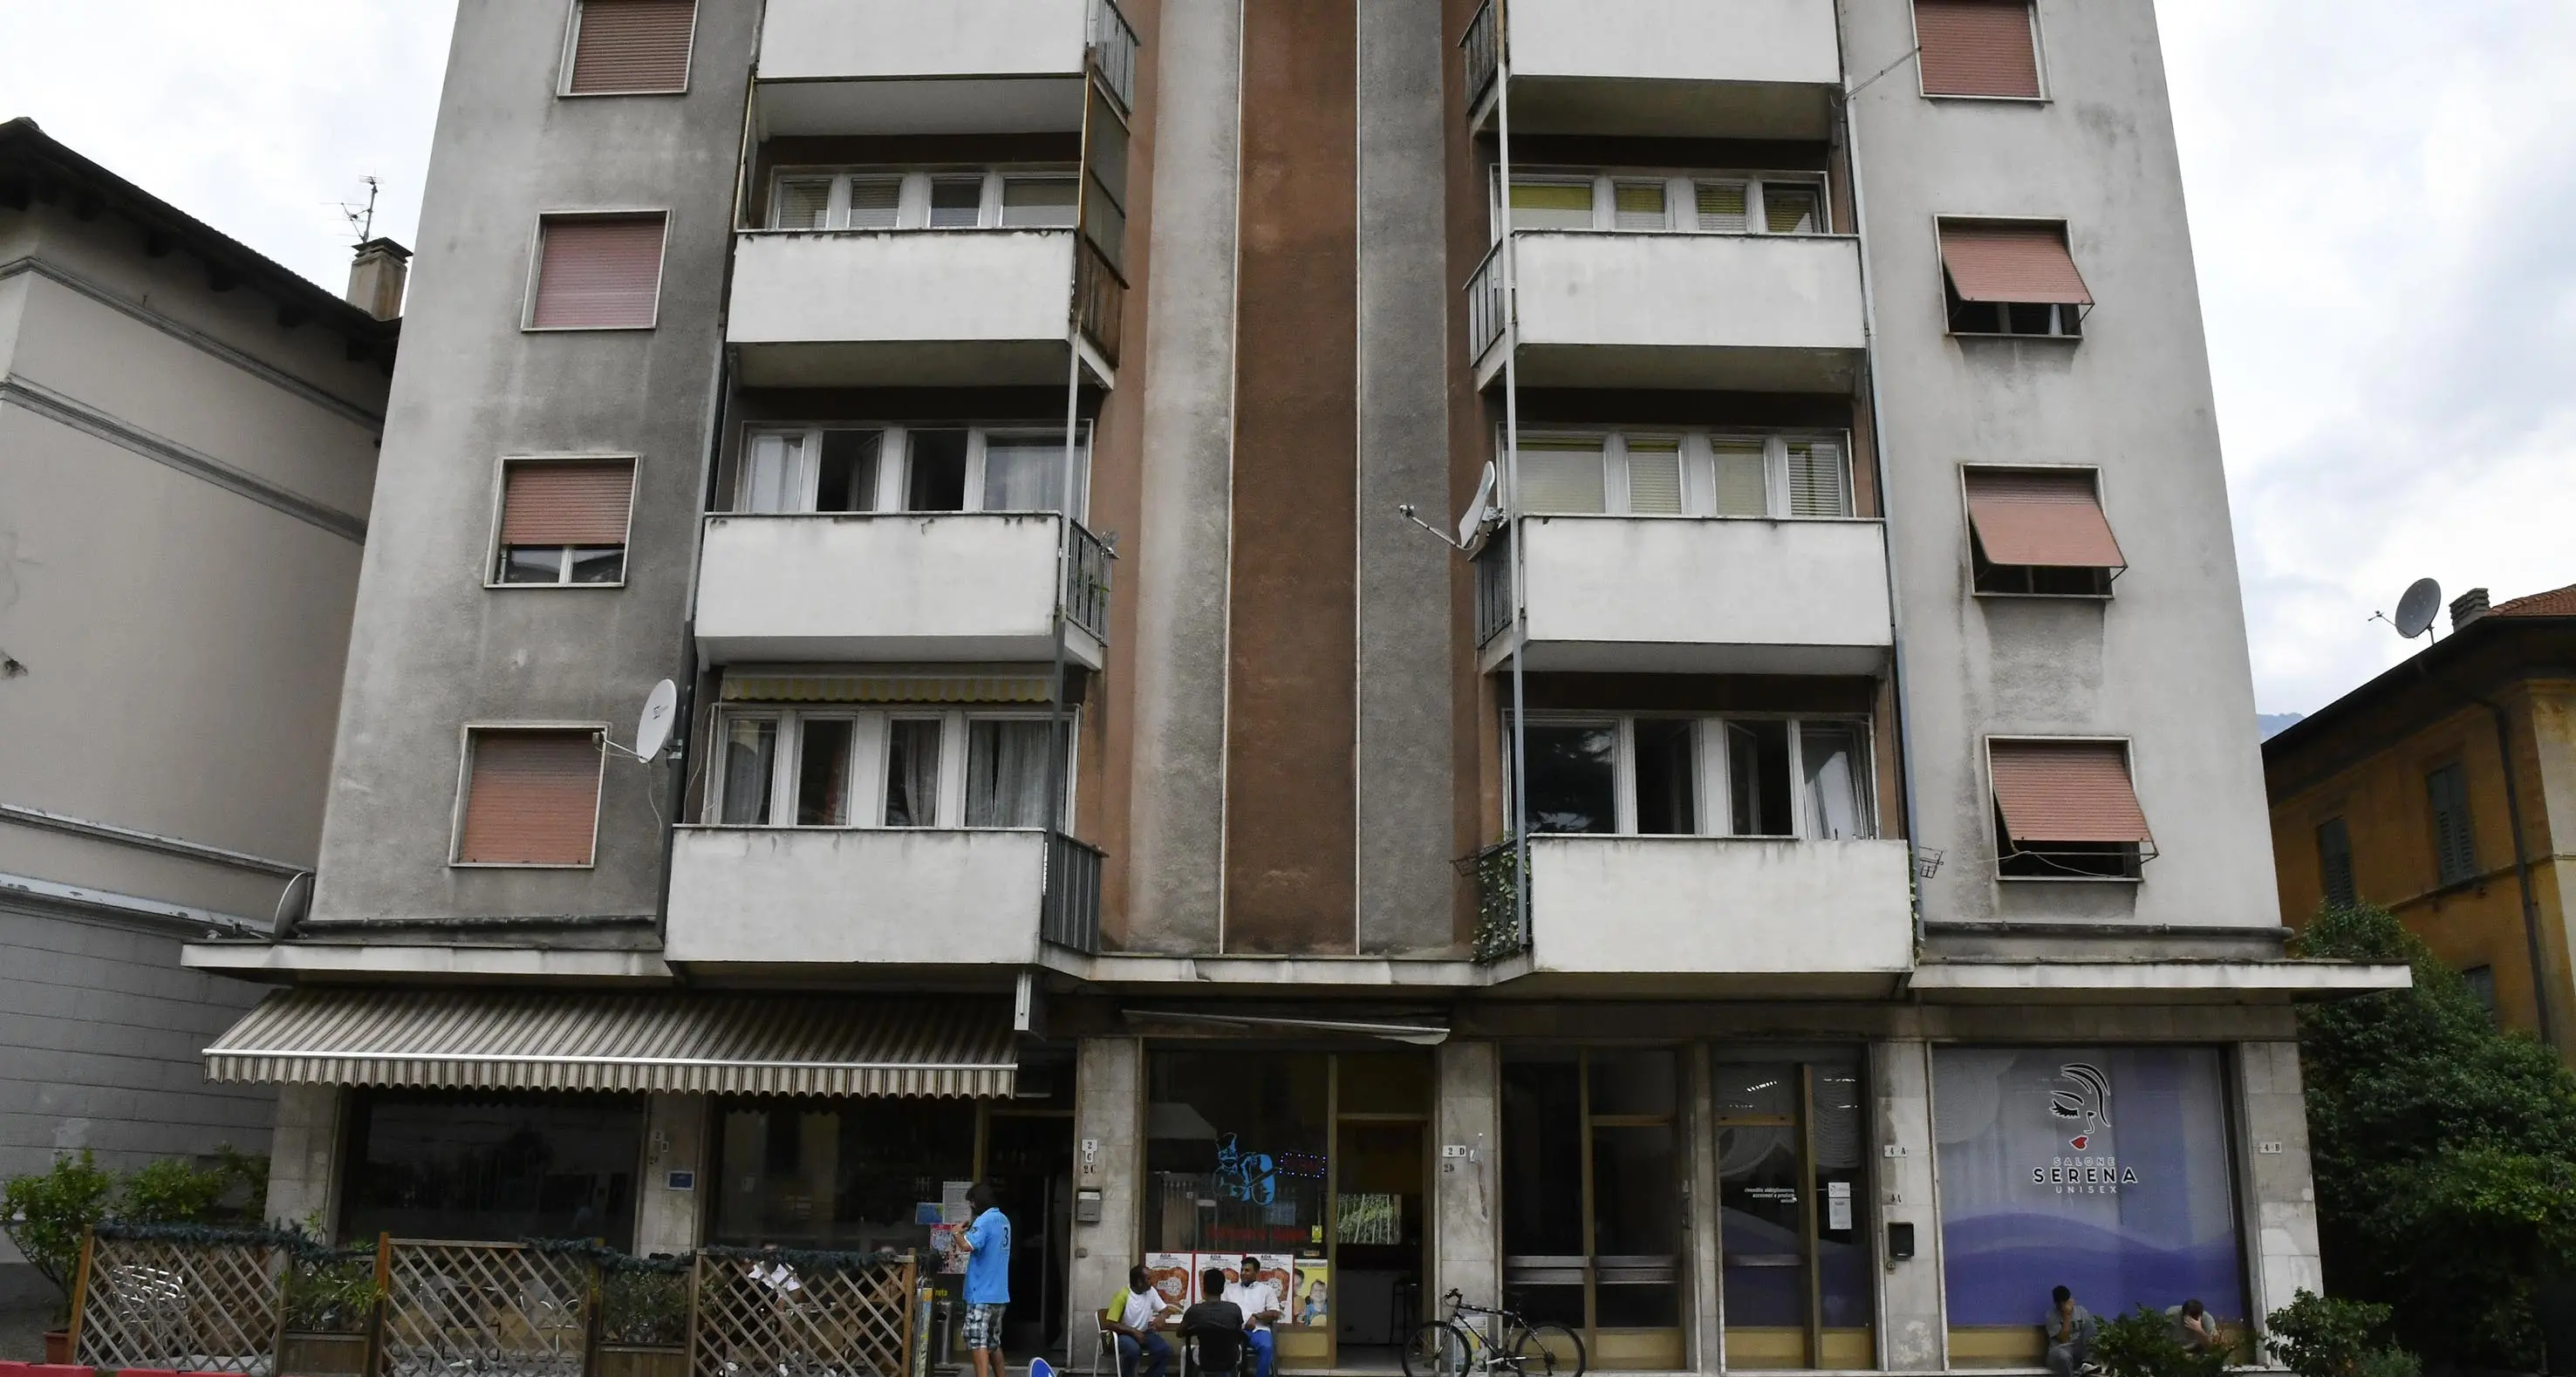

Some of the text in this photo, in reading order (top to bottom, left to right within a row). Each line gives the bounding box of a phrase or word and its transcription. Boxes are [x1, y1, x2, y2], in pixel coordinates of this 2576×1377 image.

[2053, 1156, 2115, 1167] SALONE
[2033, 1167, 2138, 1184] SERENA
[2055, 1185, 2117, 1194] UNISEX
[1001, 1226, 1008, 1248] 3
